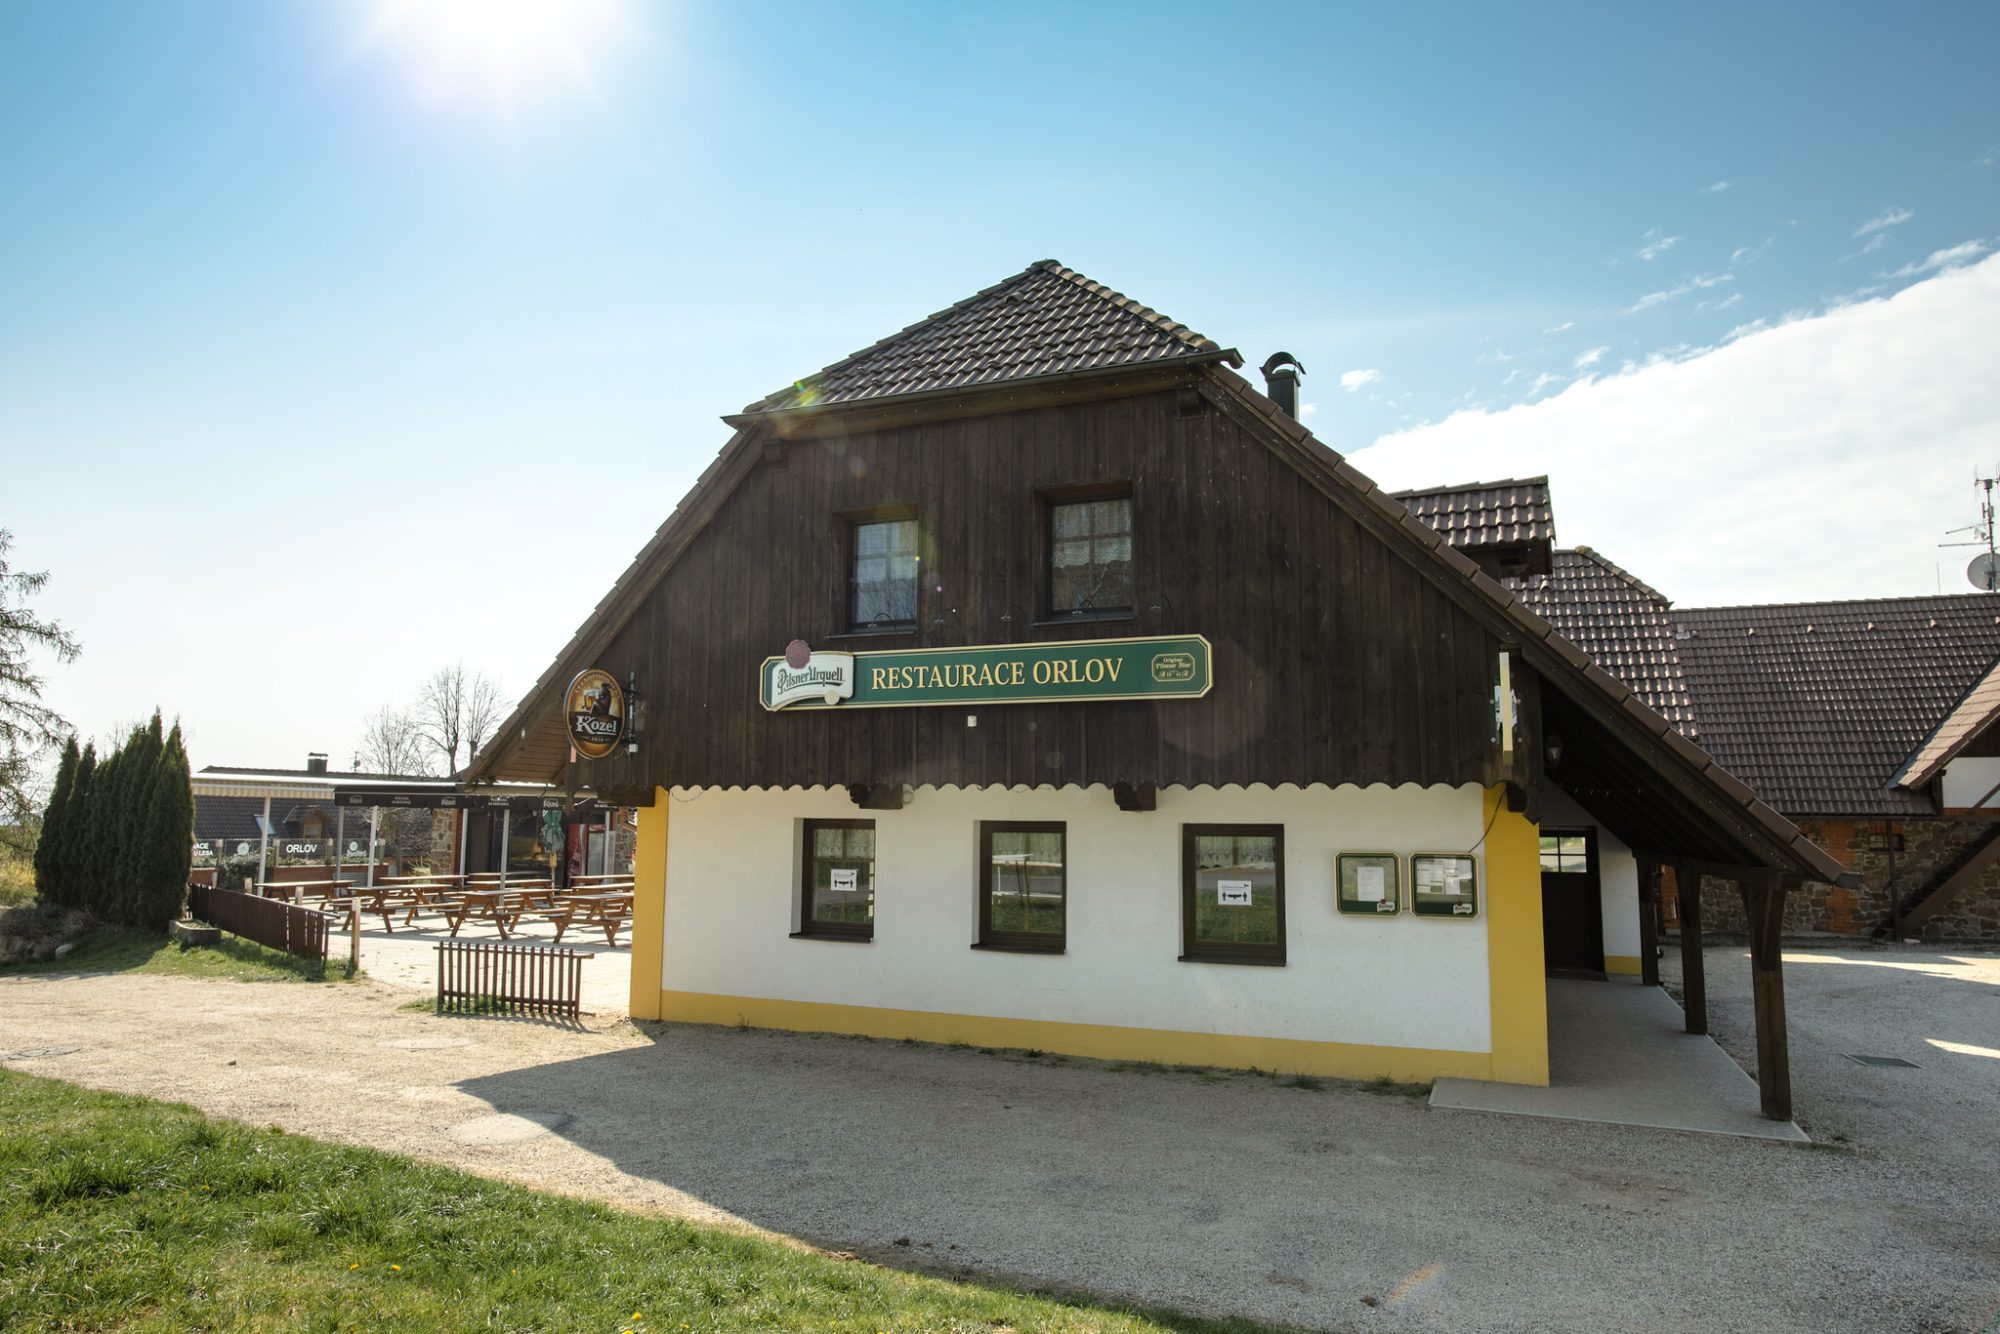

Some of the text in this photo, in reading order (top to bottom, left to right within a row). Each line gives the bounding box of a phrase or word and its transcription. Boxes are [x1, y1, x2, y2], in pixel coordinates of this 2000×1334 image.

[777, 665, 843, 695] Pilsner Urquell
[871, 657, 1124, 690] RESTAURACE ORLOV
[575, 715, 617, 735] Kozel
[286, 844, 317, 853] ORLOV
